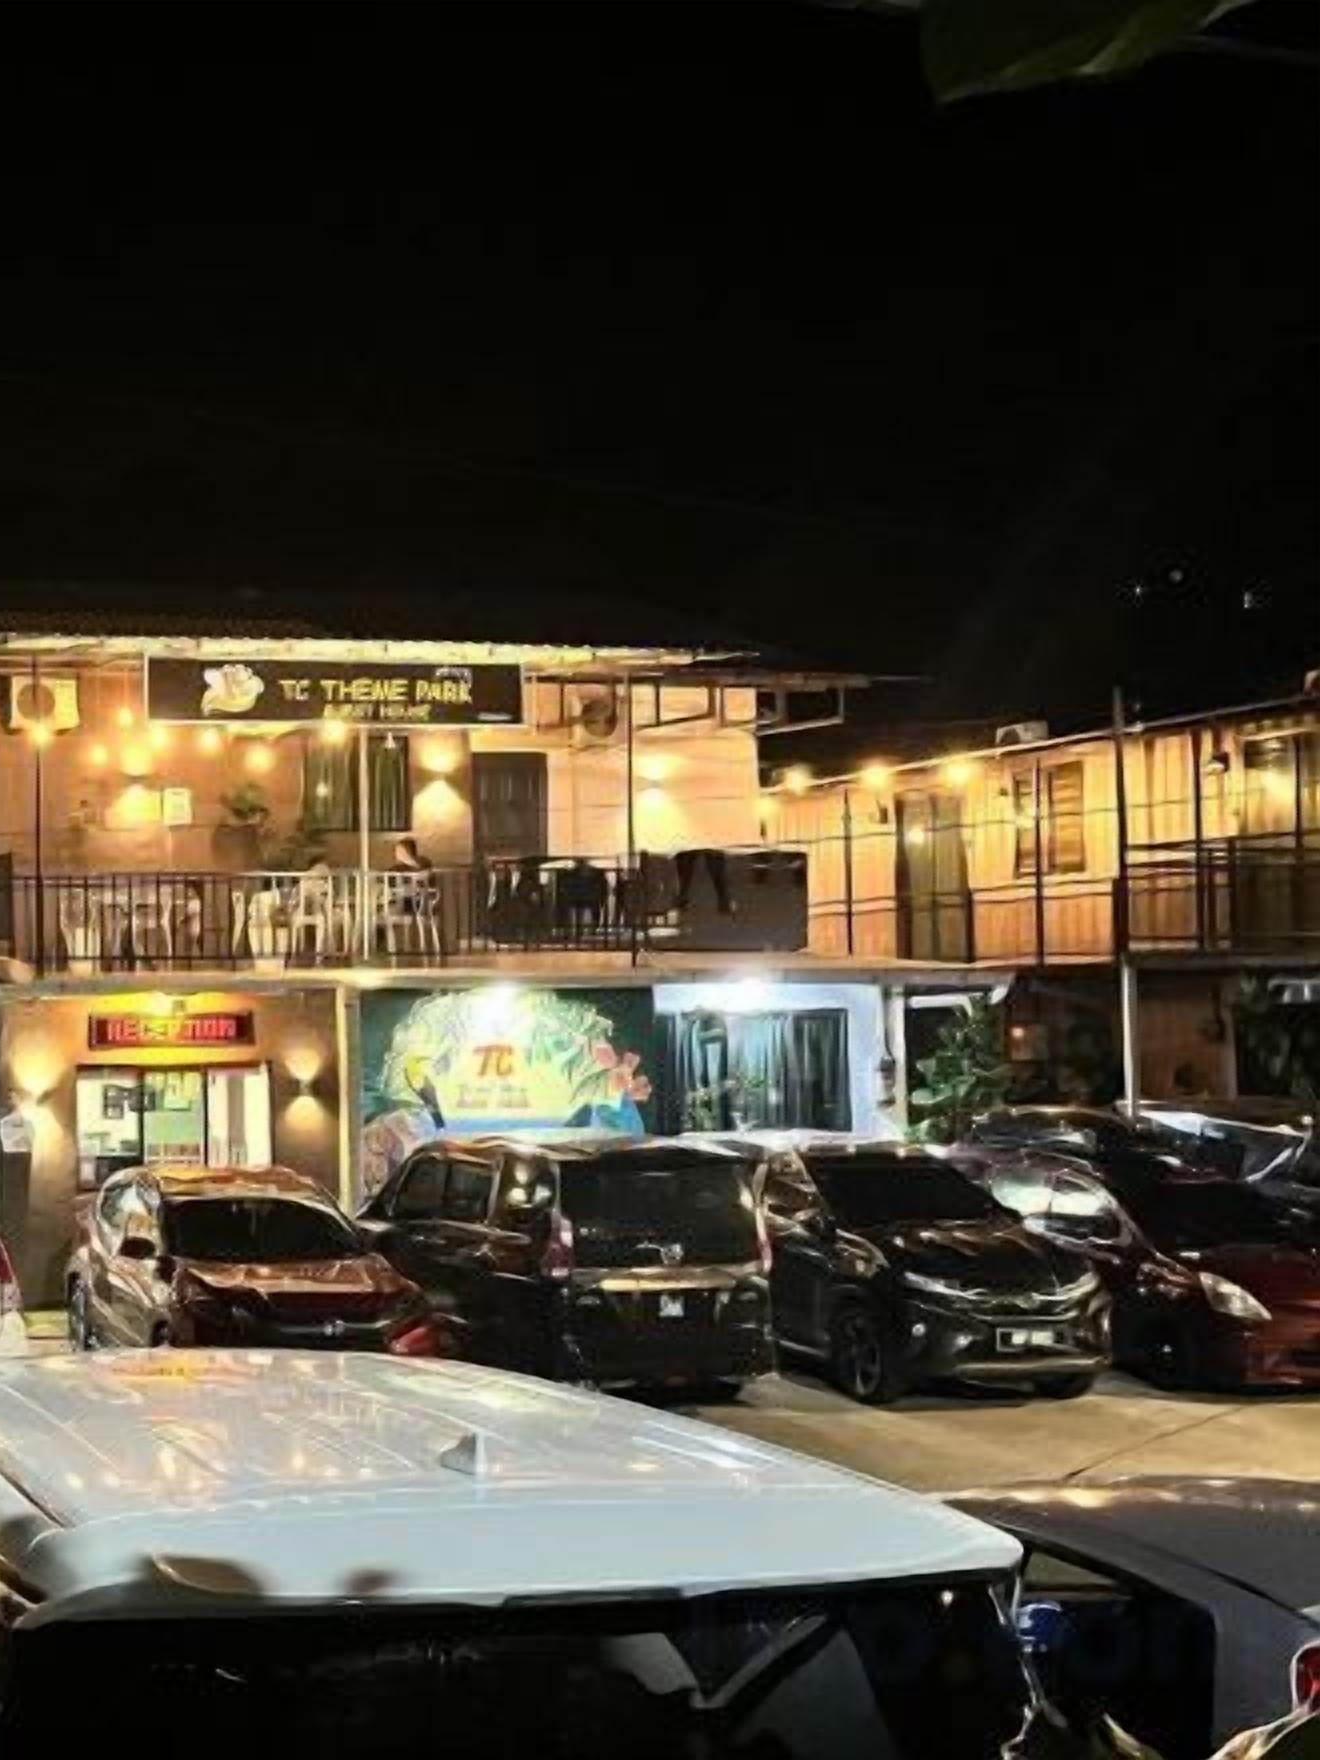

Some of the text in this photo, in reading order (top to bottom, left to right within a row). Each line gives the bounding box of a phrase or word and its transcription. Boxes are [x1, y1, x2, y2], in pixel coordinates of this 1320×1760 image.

[279, 679, 309, 701] TC
[415, 679, 473, 704] PARK
[106, 1017, 237, 1043] RETION
[472, 1044, 513, 1077] TC
